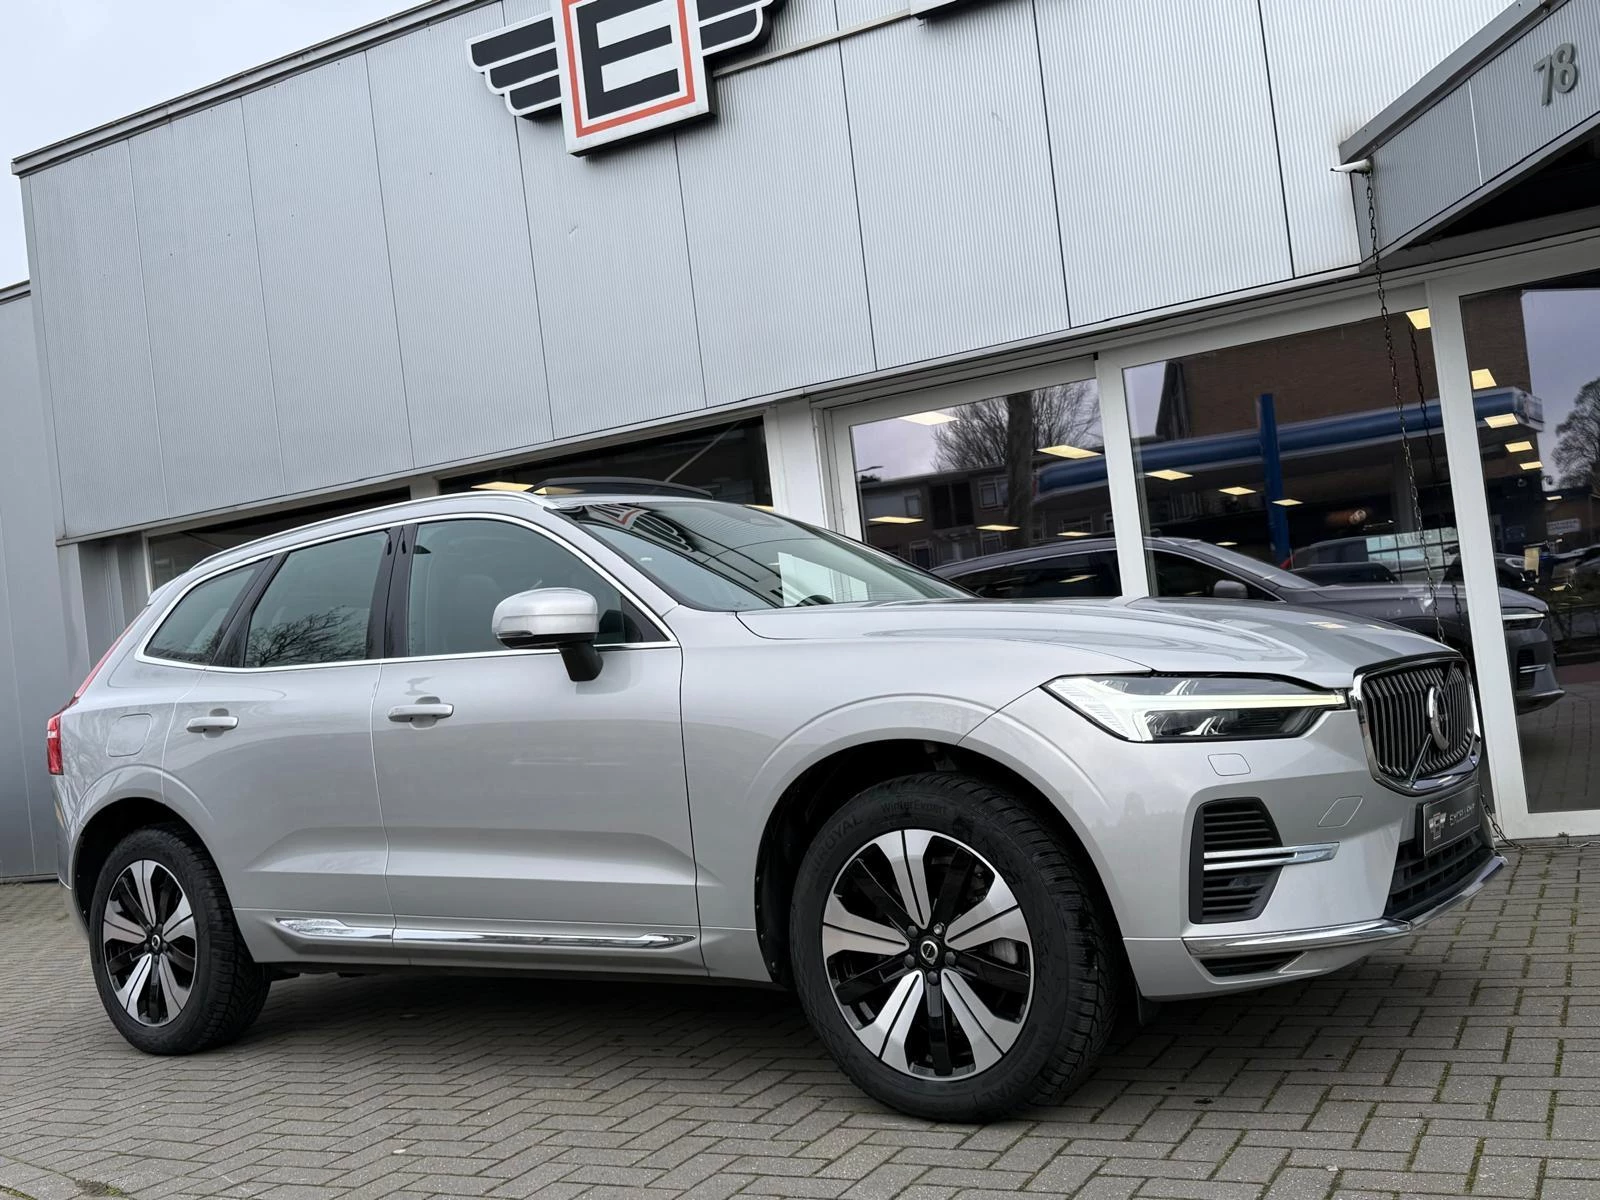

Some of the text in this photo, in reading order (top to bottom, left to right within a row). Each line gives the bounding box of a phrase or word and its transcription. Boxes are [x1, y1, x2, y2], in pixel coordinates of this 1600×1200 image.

[576, 0, 680, 120] E
[1533, 42, 1578, 107] 78
[809, 813, 863, 876] NIROYAL
